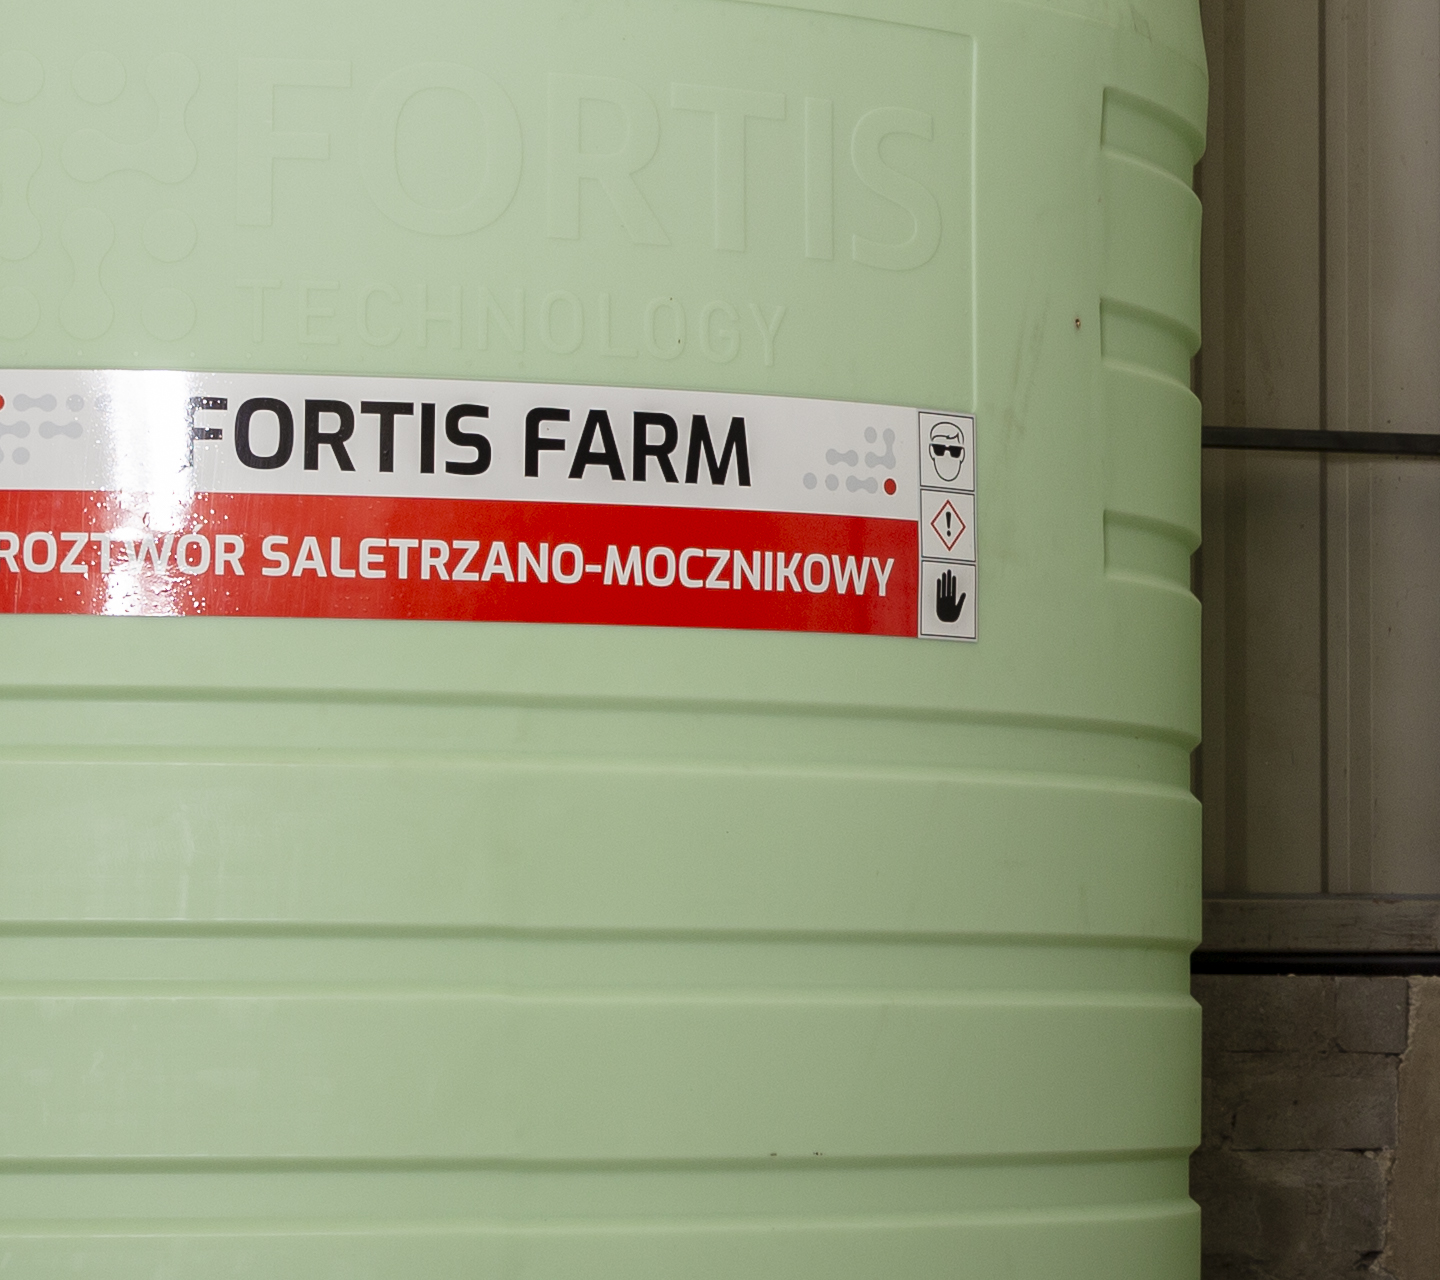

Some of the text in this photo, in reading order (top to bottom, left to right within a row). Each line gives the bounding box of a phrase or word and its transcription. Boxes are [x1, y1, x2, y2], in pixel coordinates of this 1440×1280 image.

[236, 56, 946, 273] FORTIS
[236, 278, 787, 368] TECHNOLOGY
[188, 396, 752, 487] FORTIS FARM
[260, 535, 896, 597] SALETRZANO-MOCZNIKOWY
